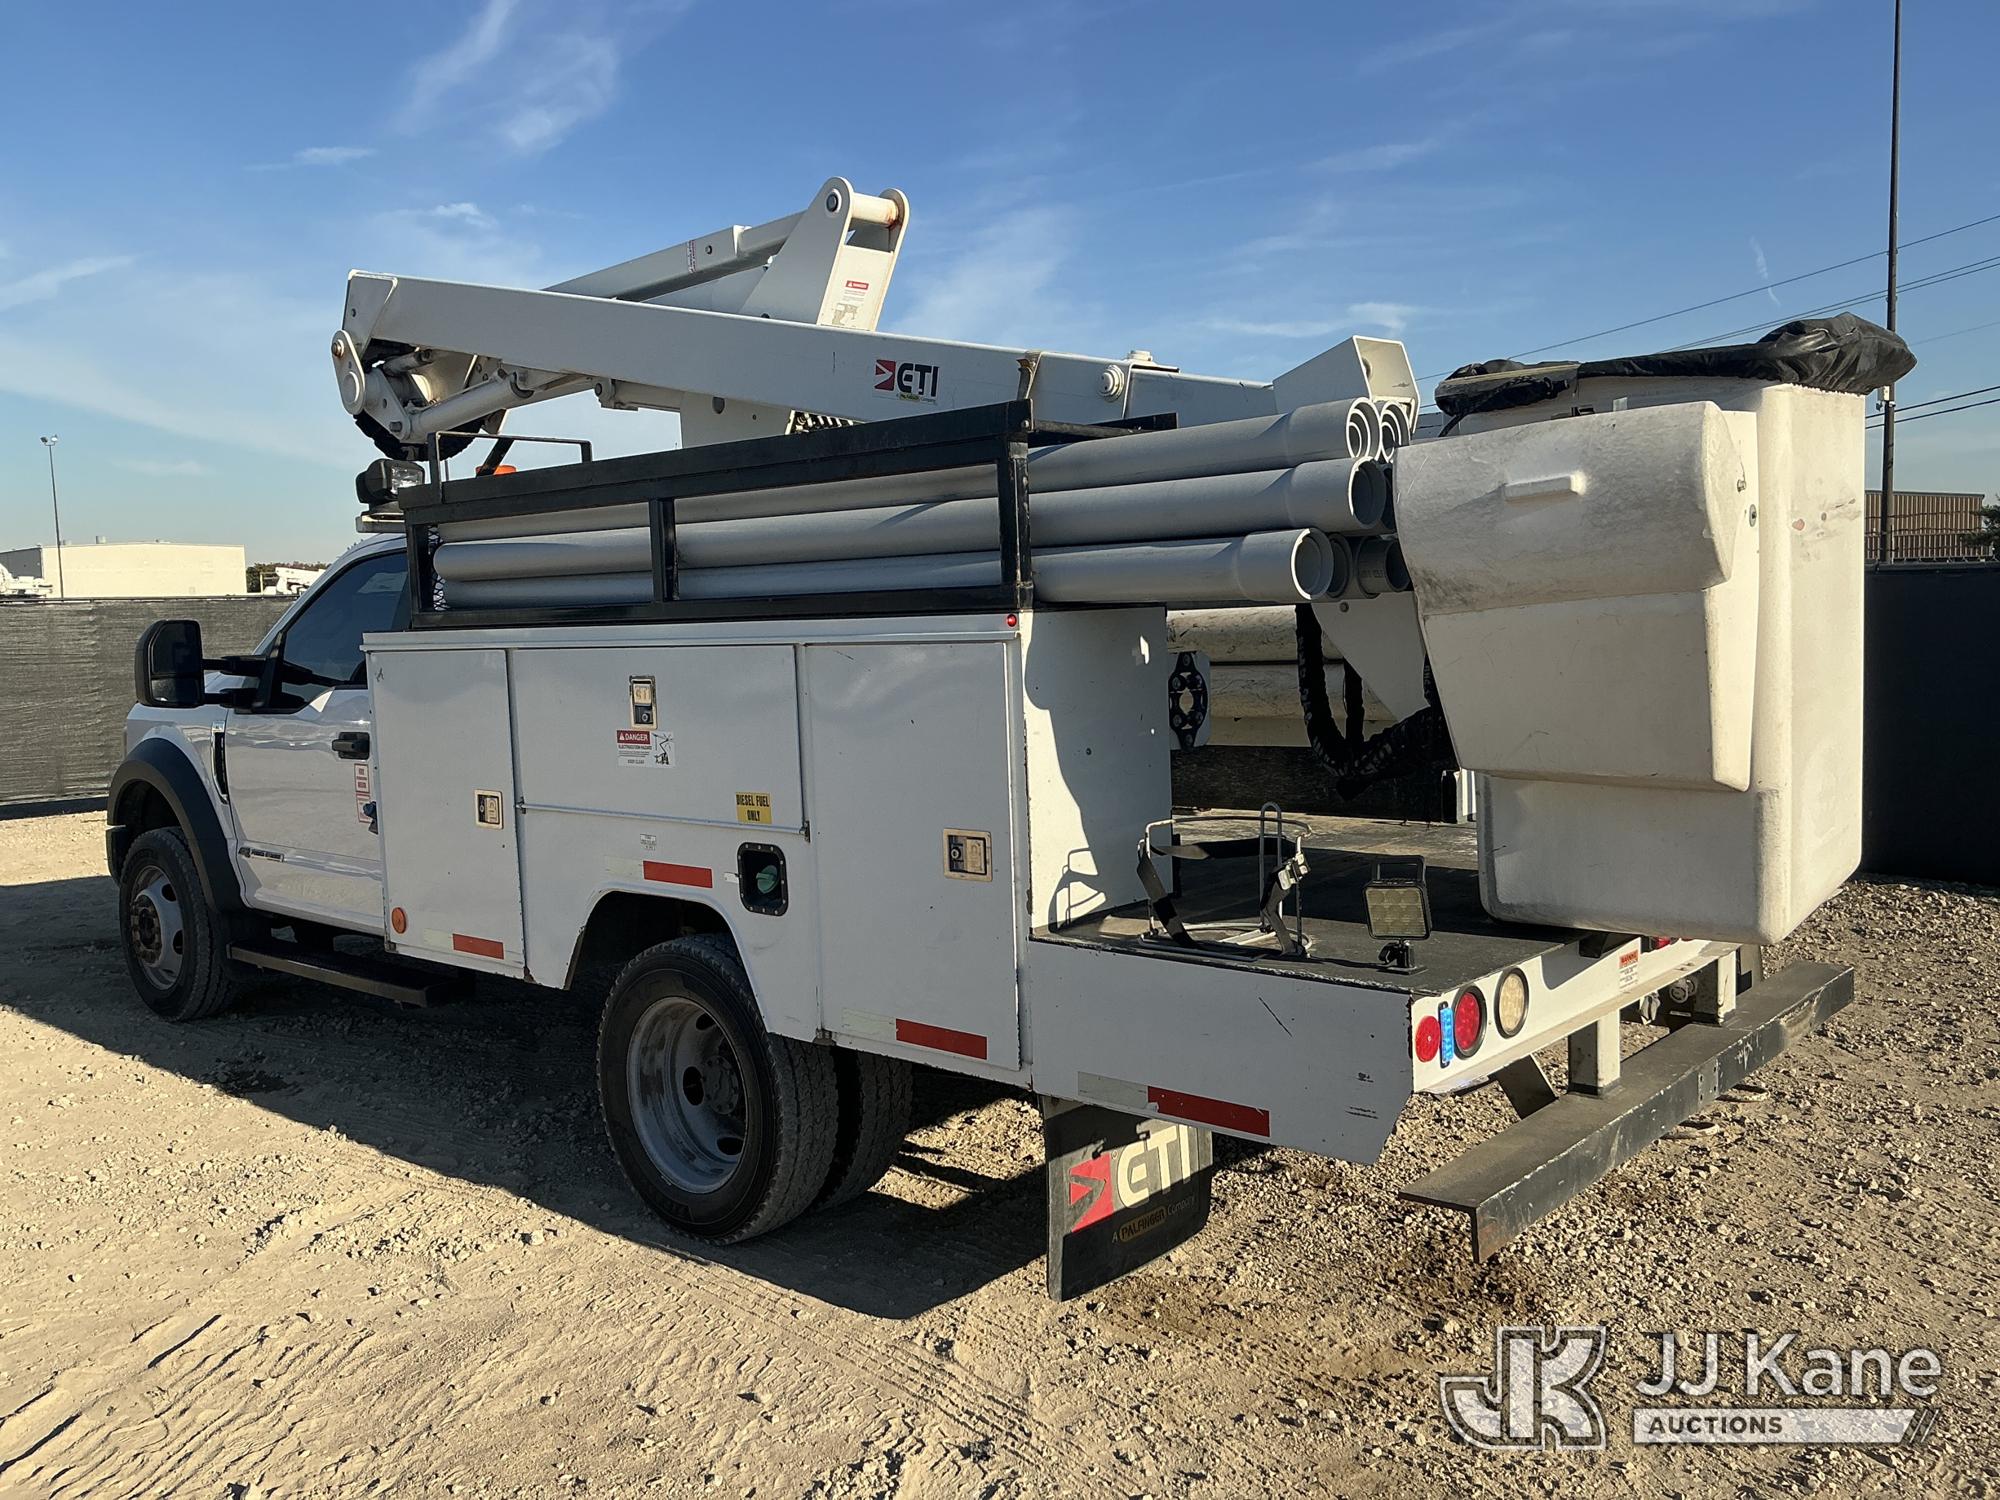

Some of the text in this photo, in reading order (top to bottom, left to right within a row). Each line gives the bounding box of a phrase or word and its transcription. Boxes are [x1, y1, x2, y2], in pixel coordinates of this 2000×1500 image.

[897, 362, 939, 397] ETI
[624, 733, 648, 741] DANGER
[736, 794, 770, 807] DIESEL FUEL
[747, 809, 760, 822] ONLY
[1118, 1125, 1191, 1208] ETI
[1111, 1233, 1119, 1244] A
